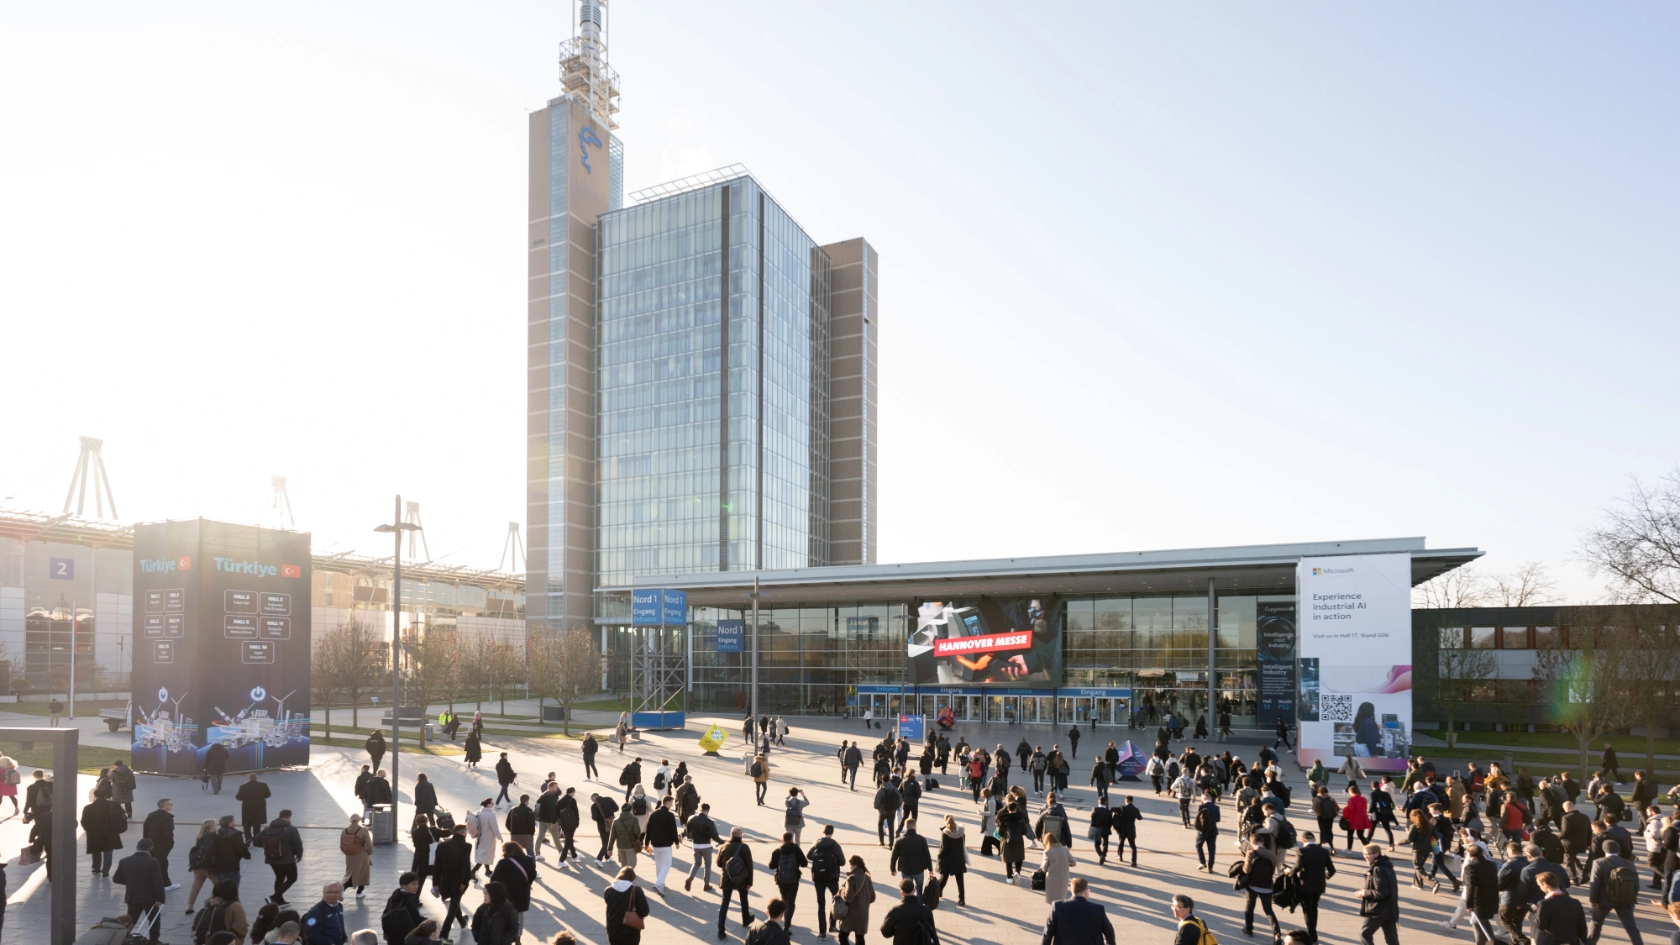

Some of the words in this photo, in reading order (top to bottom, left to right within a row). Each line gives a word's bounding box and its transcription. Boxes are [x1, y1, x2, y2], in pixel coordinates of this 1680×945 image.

[58, 562, 67, 575] 2
[140, 558, 176, 574] Türkiye
[214, 557, 277, 577] Türkiye
[633, 595, 652, 604] Nord
[653, 595, 658, 603] 1
[664, 595, 679, 604] Nord
[680, 597, 683, 605] 1
[1313, 593, 1362, 602] Experience
[1313, 602, 1355, 610] industrial
[1357, 602, 1367, 610] AI
[664, 608, 682, 617] Eingang
[718, 626, 738, 634] Nord
[739, 626, 743, 634] 1
[939, 638, 994, 652] HANNOVER
[995, 635, 1028, 647] MESSE
